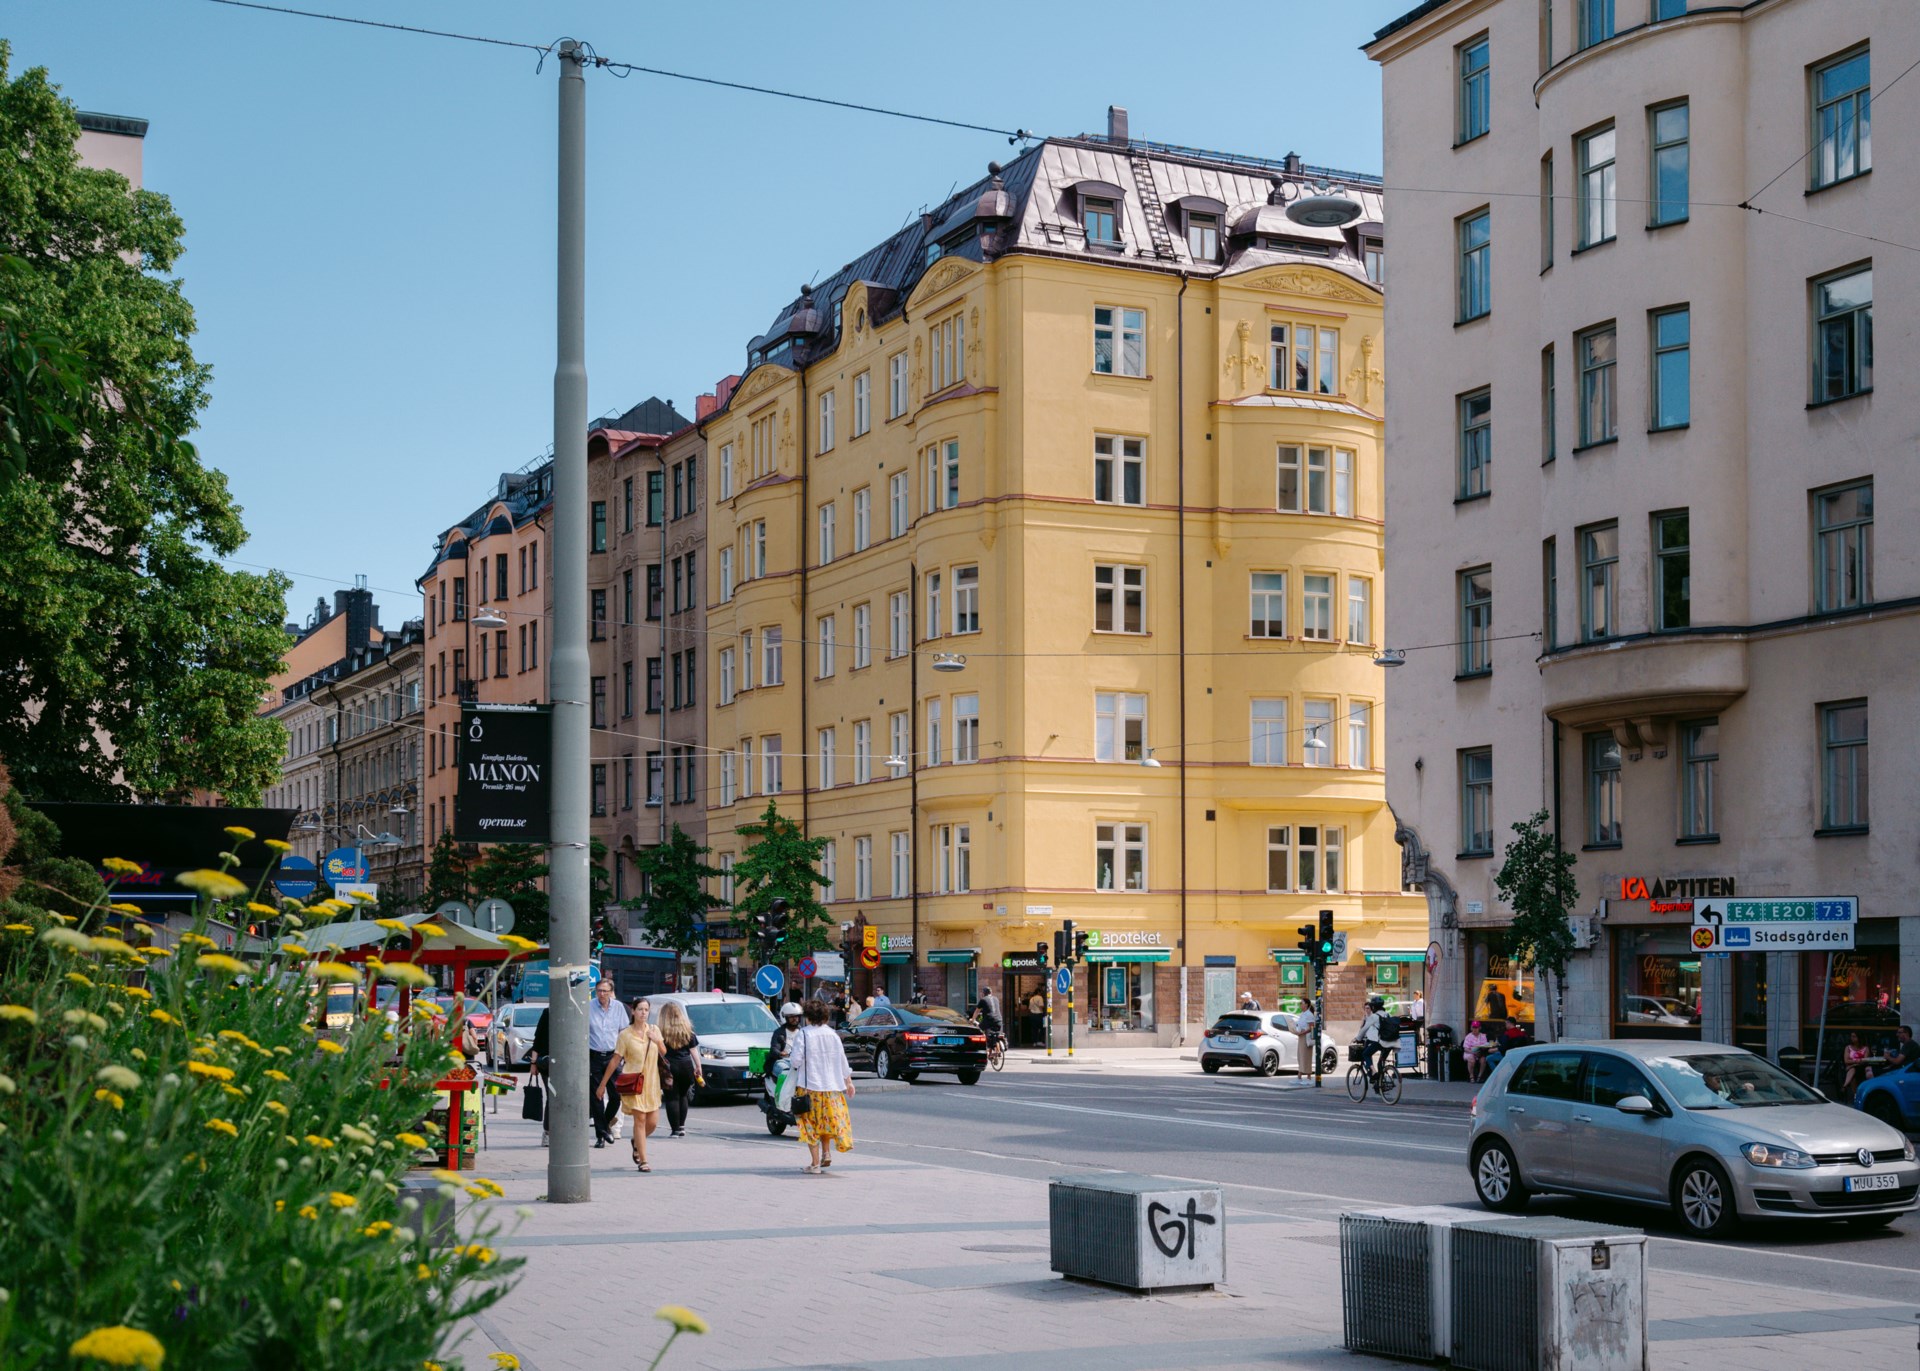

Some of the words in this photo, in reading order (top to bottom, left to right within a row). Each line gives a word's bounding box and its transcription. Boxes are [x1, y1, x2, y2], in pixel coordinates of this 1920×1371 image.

[468, 763, 540, 782] MANON
[478, 817, 526, 829] operan.se
[1621, 877, 1650, 900] ICA
[1651, 877, 1735, 898] APTITEN
[1735, 906, 1755, 918] E4
[1772, 905, 1806, 918] E20
[1823, 905, 1845, 917] 73
[887, 935, 913, 950] apoteket
[1102, 930, 1162, 946] apoteket
[1754, 930, 1849, 945] Stadsgården
[1853, 1177, 1873, 1190] MUU
[1876, 1176, 1895, 1188] 359
